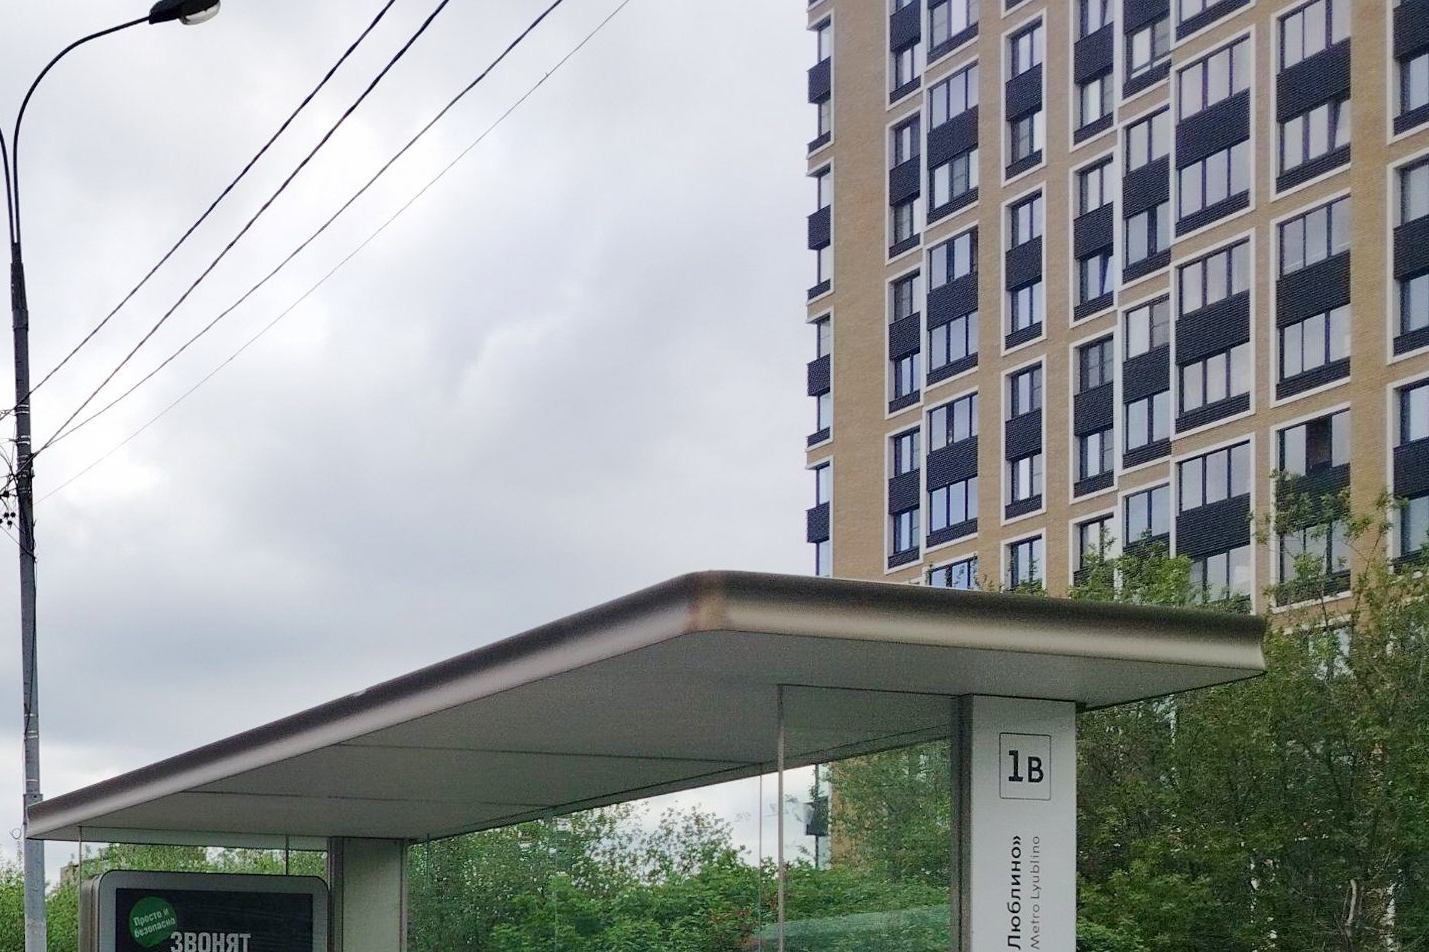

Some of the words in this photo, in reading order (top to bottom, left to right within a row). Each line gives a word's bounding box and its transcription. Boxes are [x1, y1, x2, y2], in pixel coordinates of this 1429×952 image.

[1030, 836, 1042, 899] Lyublino
[133, 910, 162, 927] Просто
[163, 908, 170, 917] и
[134, 918, 176, 938] безопасно
[1030, 902, 1040, 949] Metro
